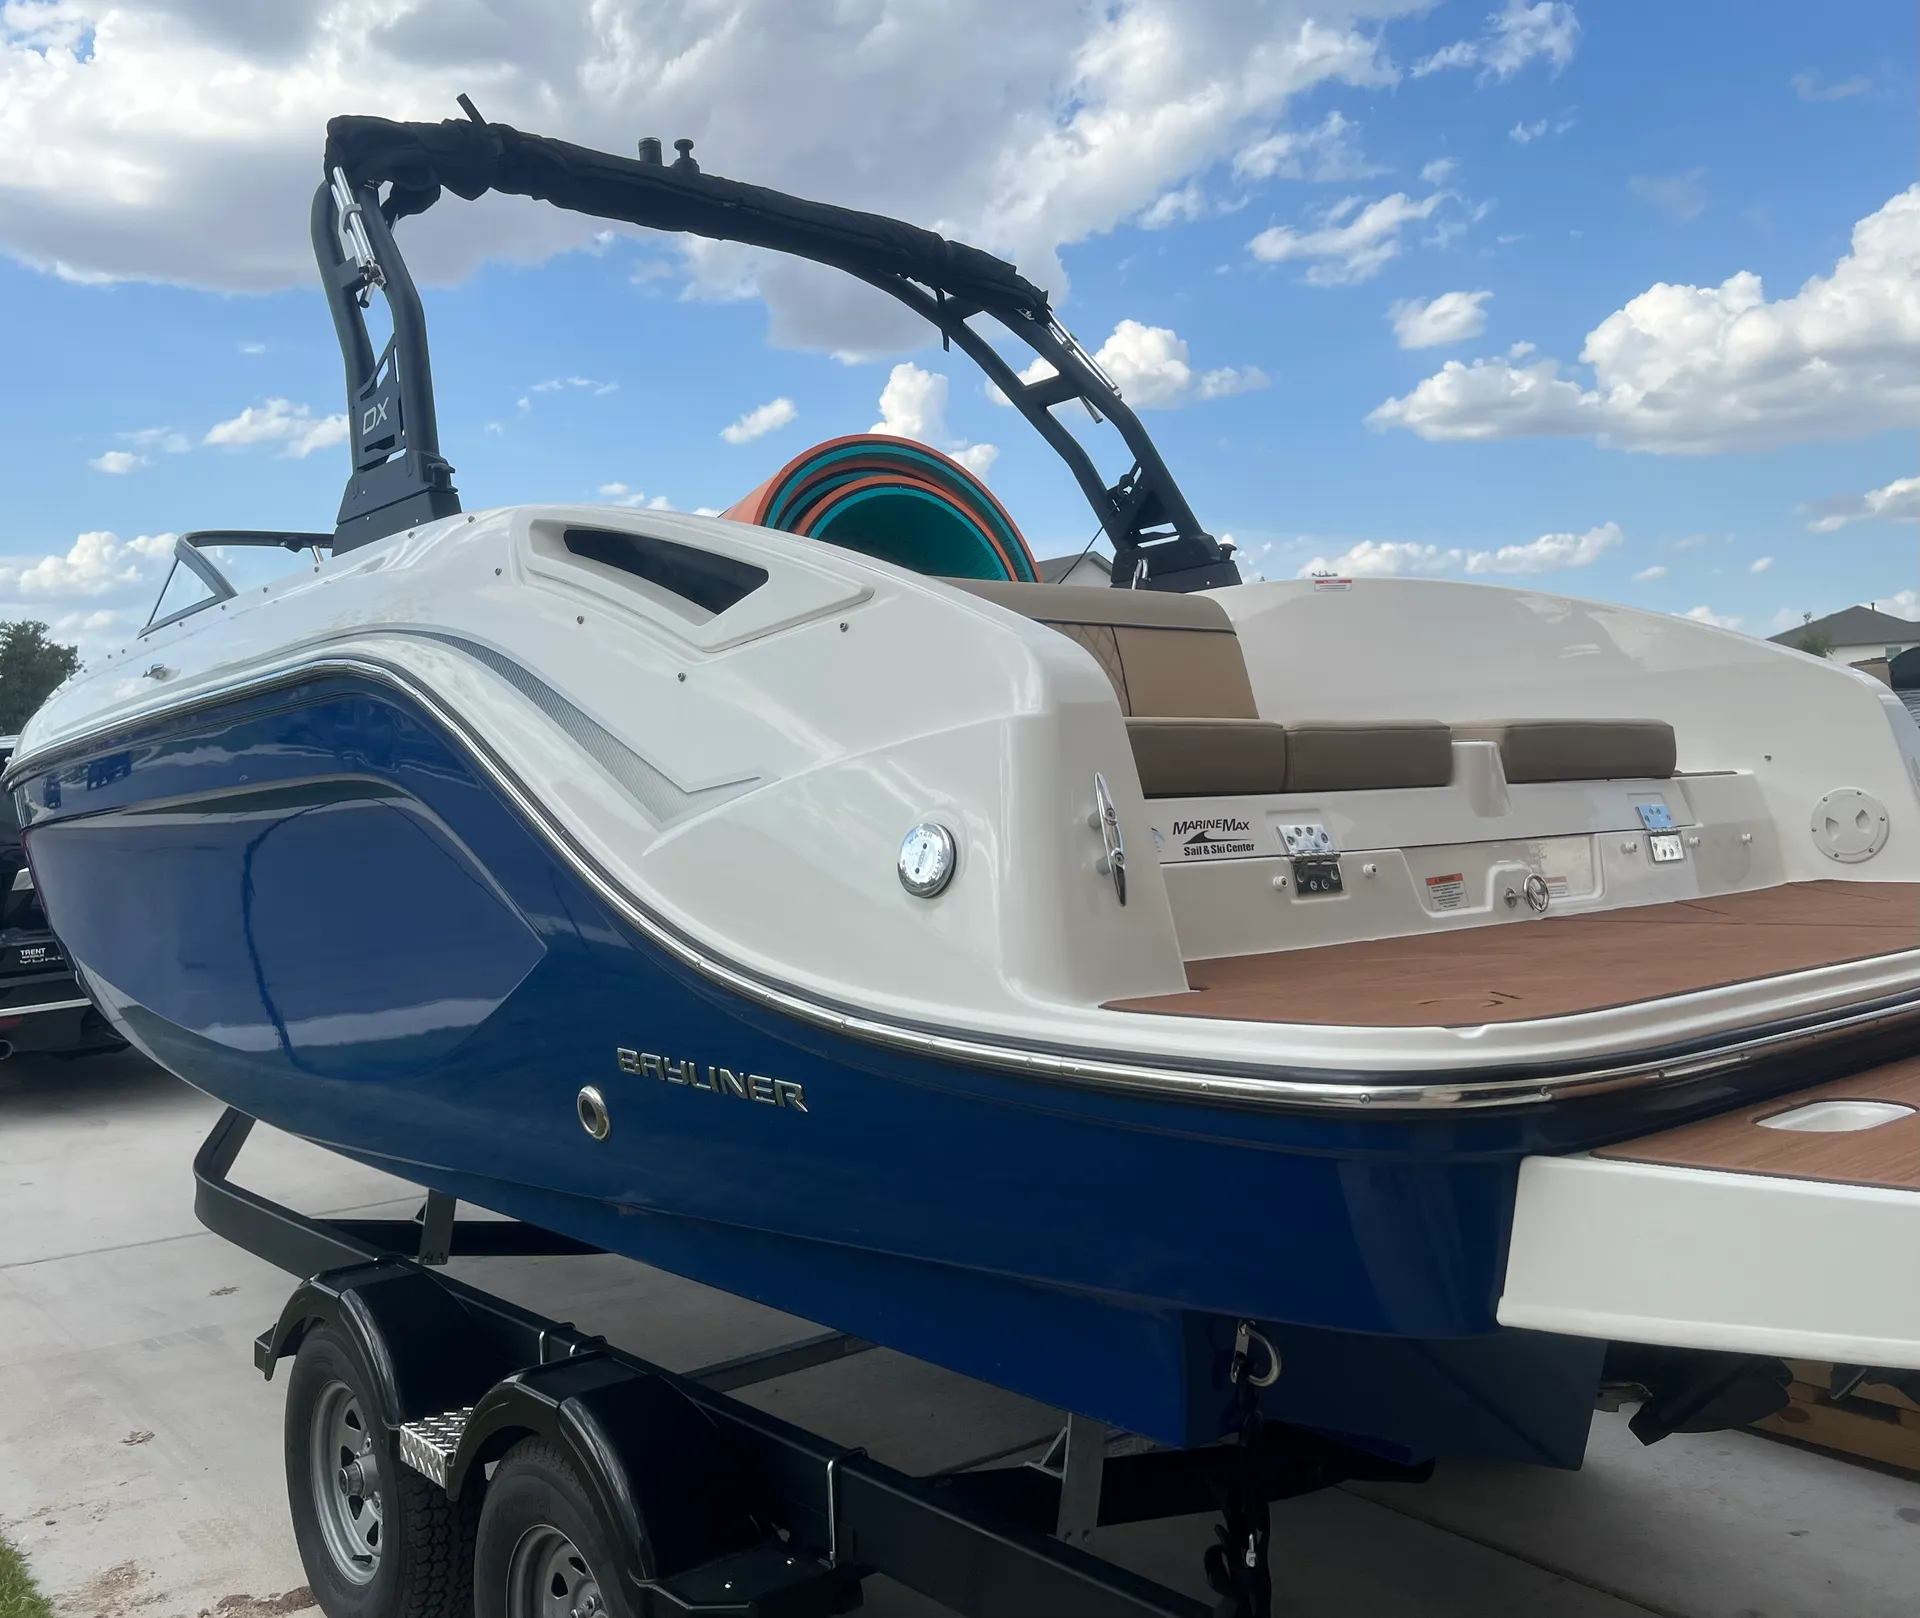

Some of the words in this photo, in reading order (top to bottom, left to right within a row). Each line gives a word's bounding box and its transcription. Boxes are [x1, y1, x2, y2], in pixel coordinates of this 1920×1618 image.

[362, 396, 389, 436] DX
[1183, 846, 1202, 857] Sail
[1203, 845, 1210, 855] &
[1210, 843, 1226, 854] Ski
[1226, 843, 1255, 853] Center
[20, 947, 46, 956] TRENT
[617, 1047, 809, 1113] BAYLINER
